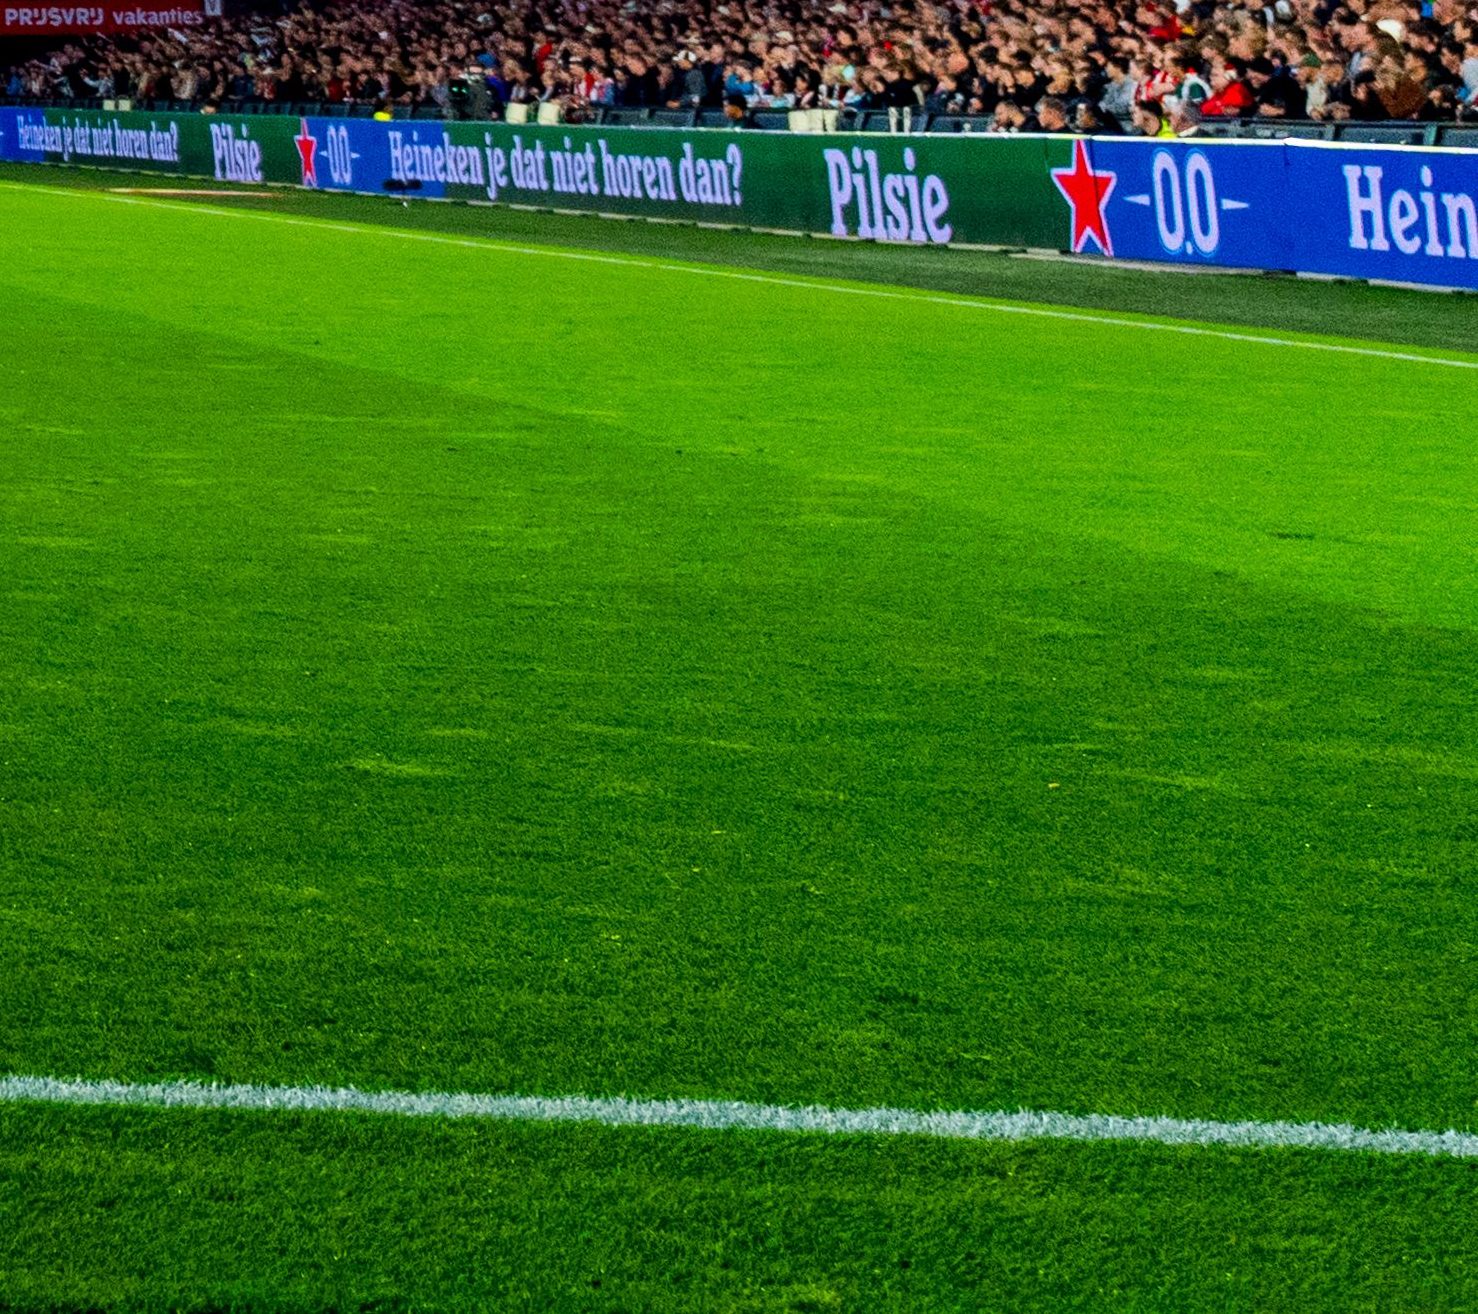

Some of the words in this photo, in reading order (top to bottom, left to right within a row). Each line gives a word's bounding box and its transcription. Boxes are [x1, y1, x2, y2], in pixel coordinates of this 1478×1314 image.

[112, 7, 203, 27] vakanties
[209, 122, 263, 183] Pilsie
[388, 131, 483, 186] Heineken
[485, 133, 508, 201] je
[510, 134, 548, 191] dat
[551, 135, 596, 196] niet
[598, 139, 676, 201] horen
[678, 141, 742, 207] dan?
[824, 145, 953, 245] Pilsie
